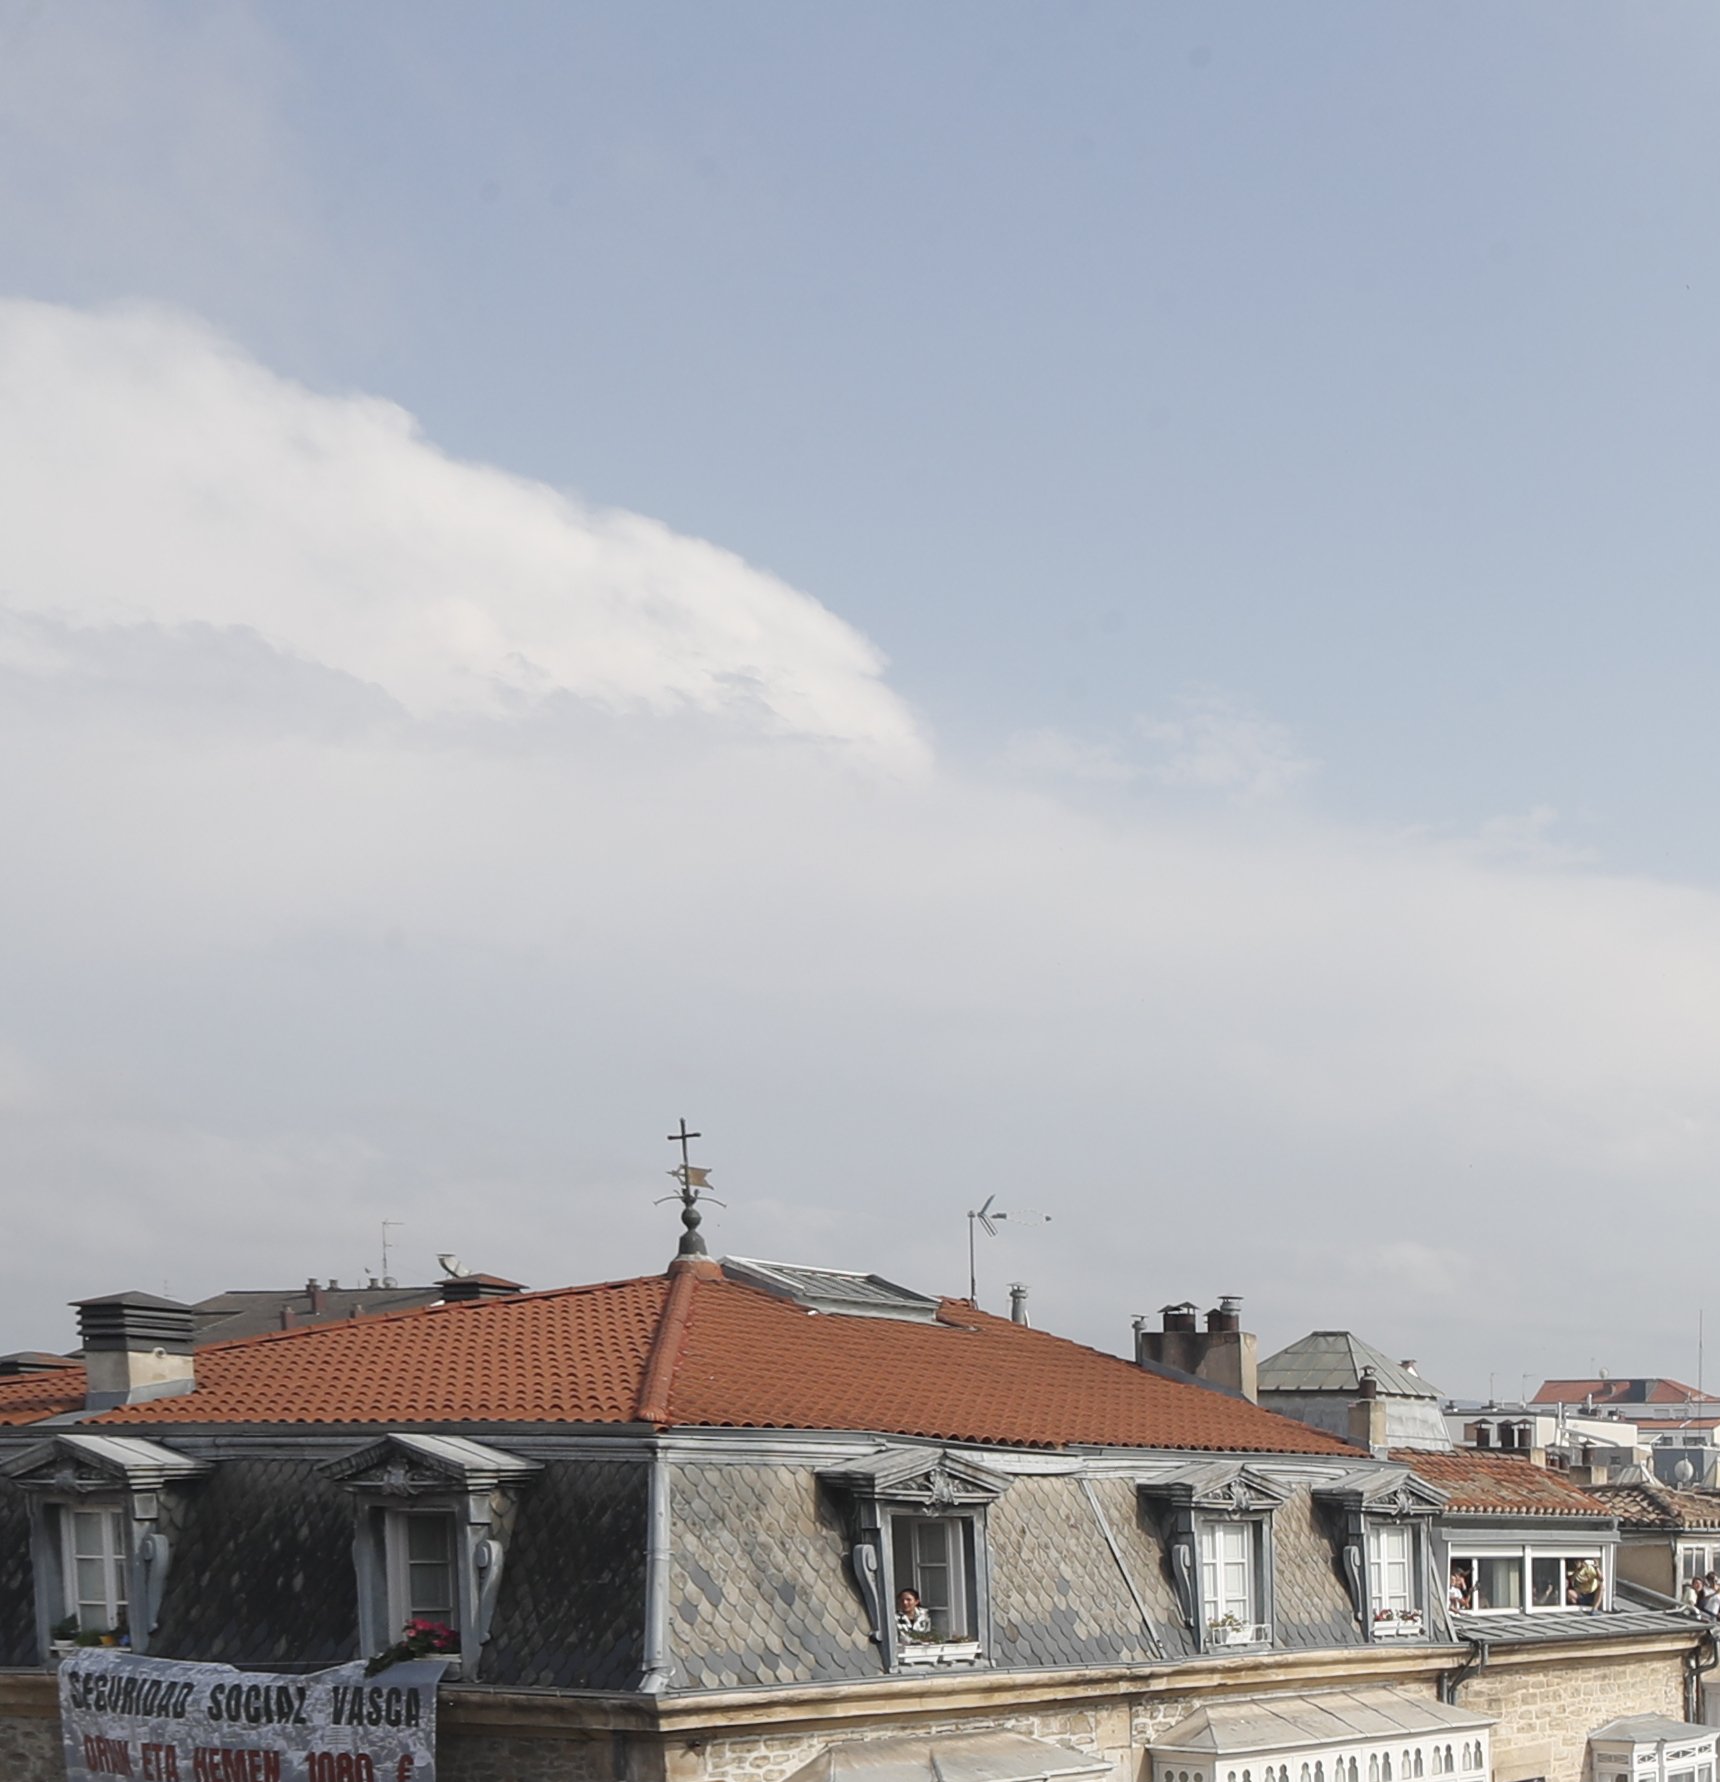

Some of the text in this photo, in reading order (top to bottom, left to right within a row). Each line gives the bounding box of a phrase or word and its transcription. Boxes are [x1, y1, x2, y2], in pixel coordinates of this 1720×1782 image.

[68, 1670, 421, 1728] SEGURIDAD SOCIAL VASCA
